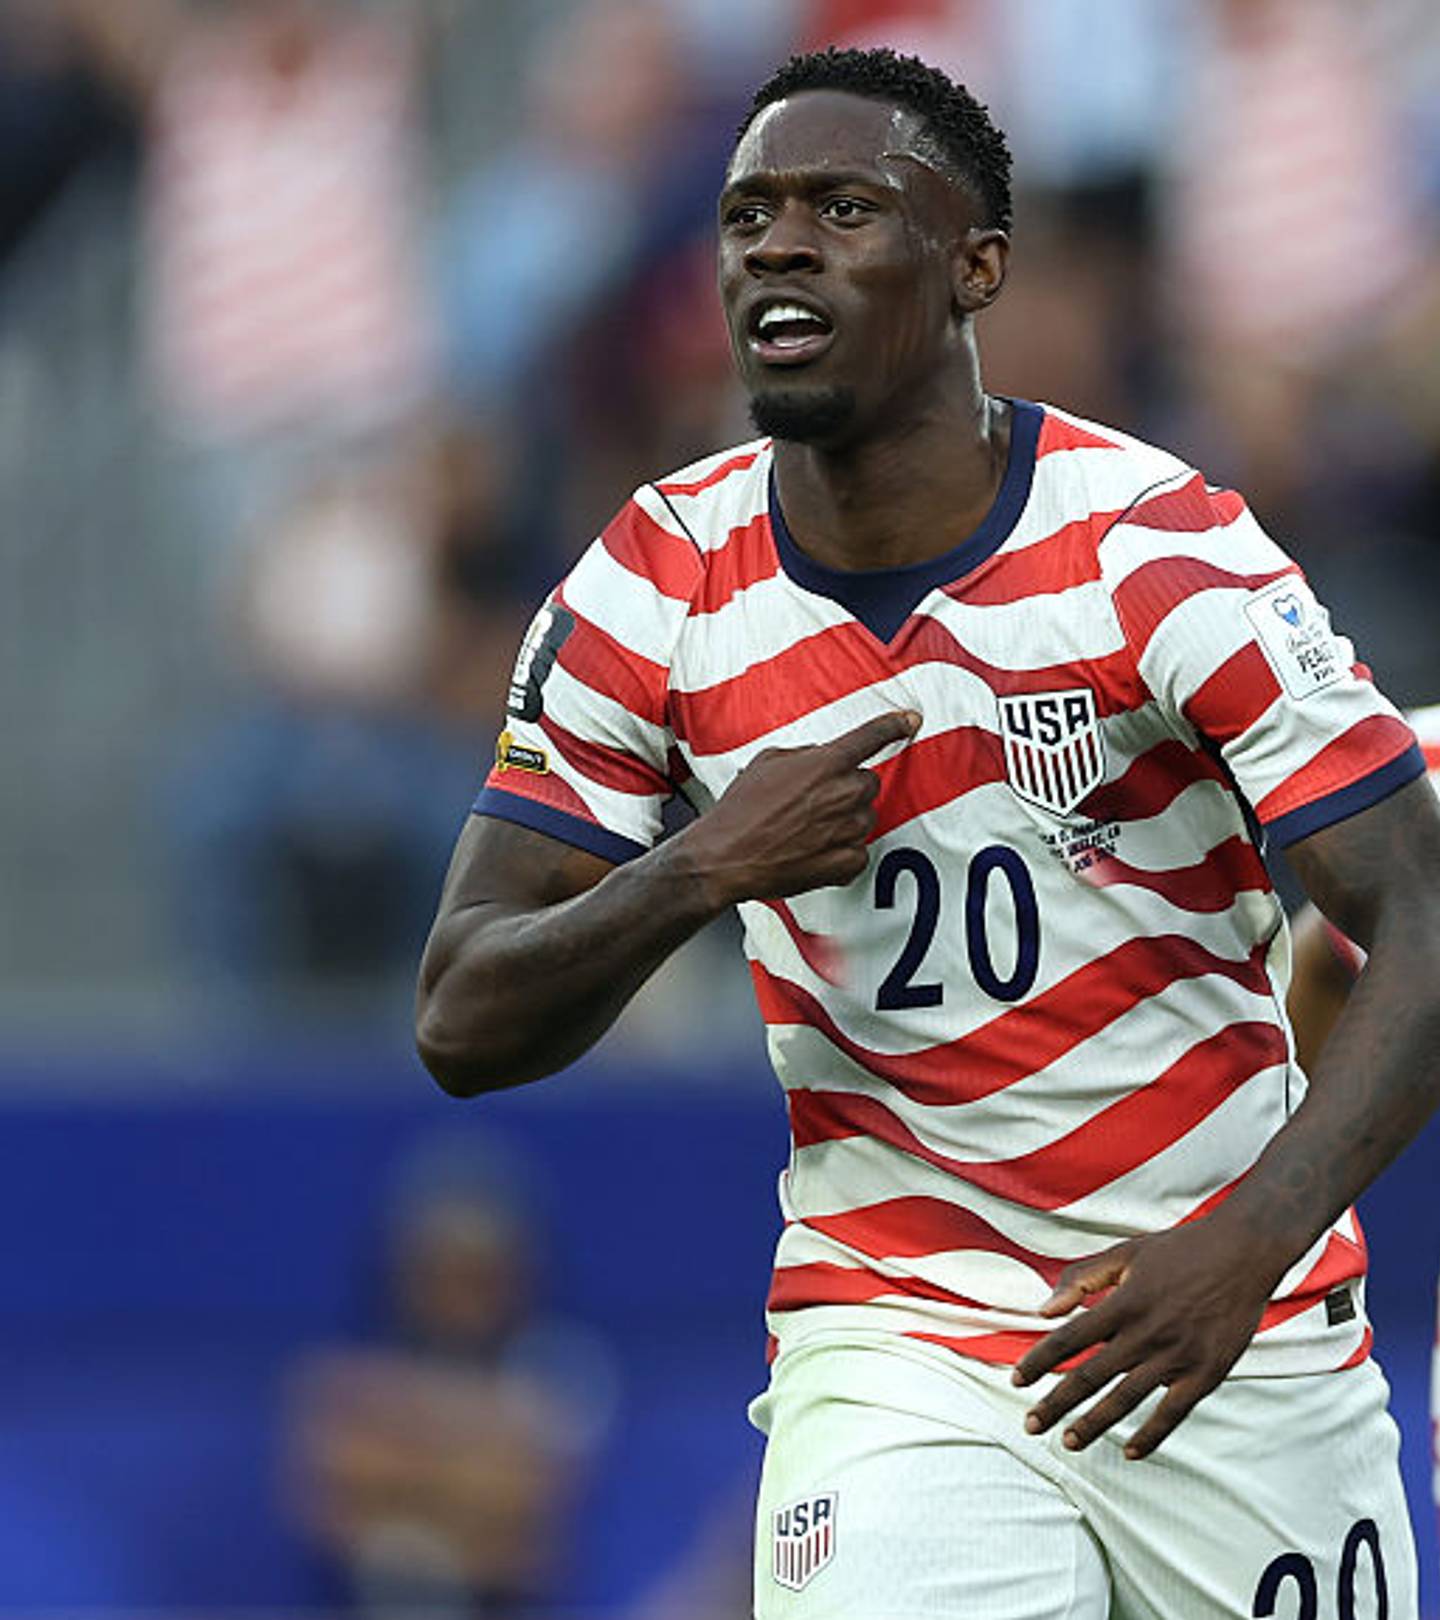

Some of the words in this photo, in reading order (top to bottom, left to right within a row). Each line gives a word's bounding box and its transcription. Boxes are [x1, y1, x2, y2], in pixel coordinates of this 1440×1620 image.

[1004, 696, 1090, 746] USA
[874, 844, 1041, 1011] 20
[776, 1498, 831, 1537] USA
